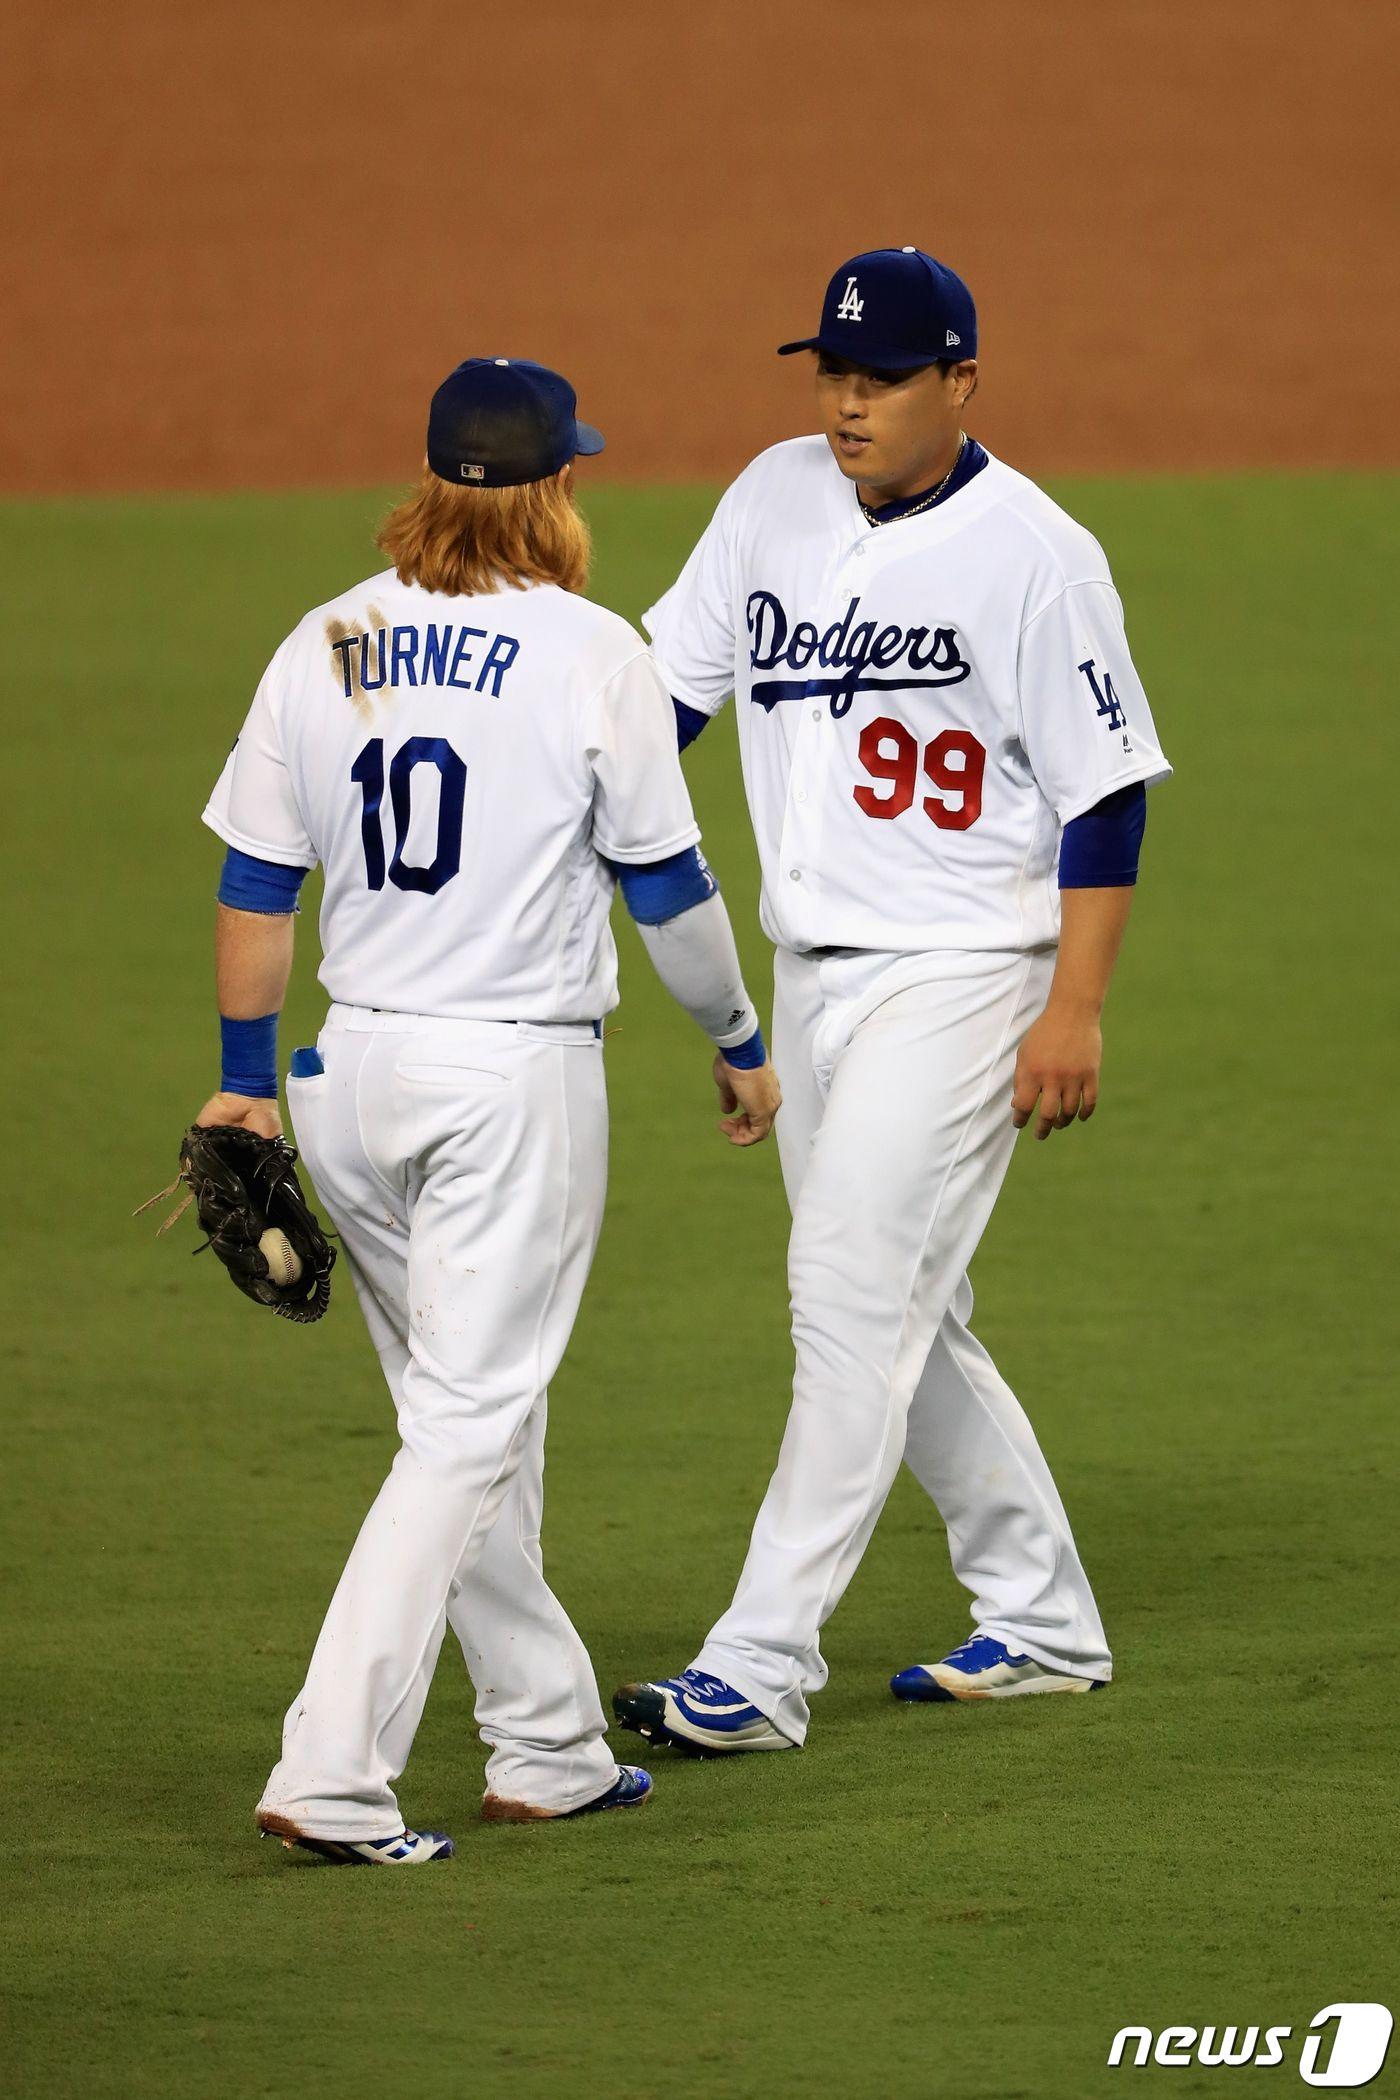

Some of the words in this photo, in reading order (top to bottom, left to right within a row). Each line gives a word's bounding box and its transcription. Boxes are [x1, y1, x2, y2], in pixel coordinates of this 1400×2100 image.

[837, 276, 865, 322] LA
[332, 624, 521, 698] TURNER
[746, 590, 971, 719] Dodgers
[1077, 658, 1127, 731] LA
[351, 736, 468, 896] 10
[853, 716, 987, 832] 99
